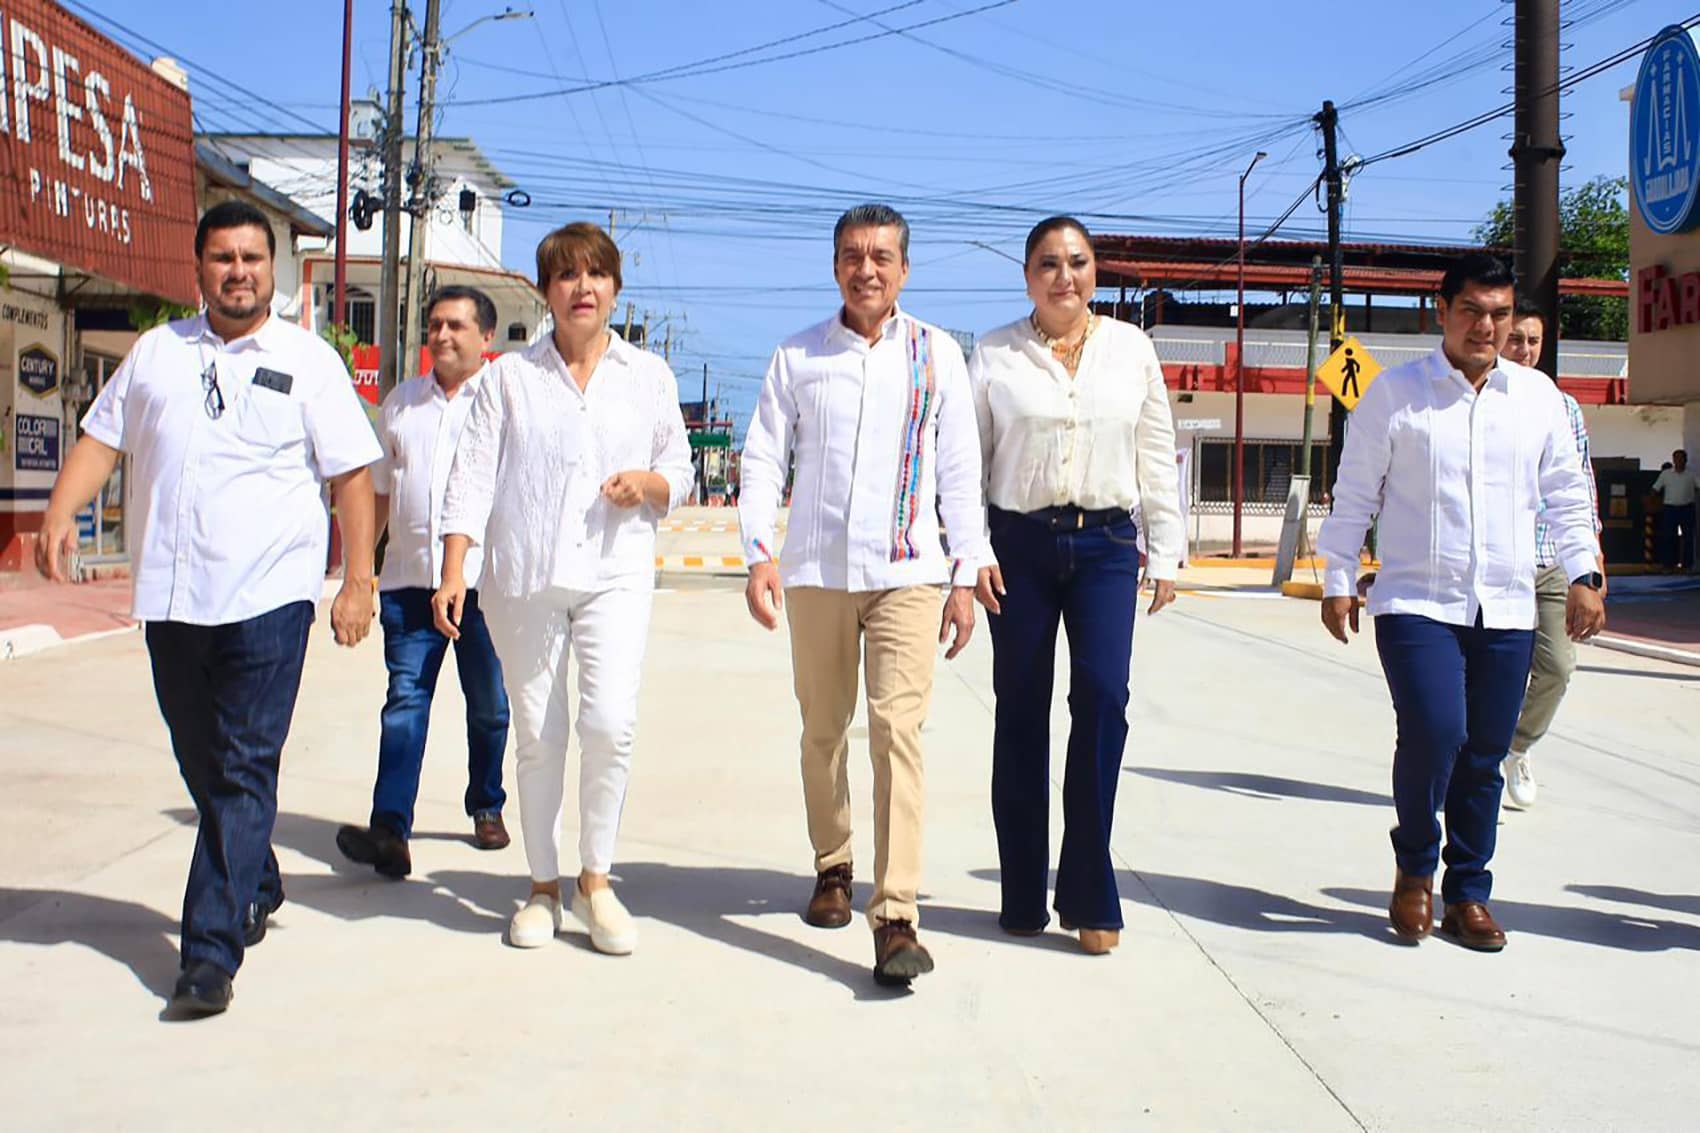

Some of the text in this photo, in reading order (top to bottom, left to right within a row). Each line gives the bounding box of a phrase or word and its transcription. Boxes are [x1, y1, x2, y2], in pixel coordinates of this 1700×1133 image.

[1662, 50, 1672, 154] FARMACIAS
[21, 357, 55, 375] CENTURY
[18, 416, 46, 435] COLOR
